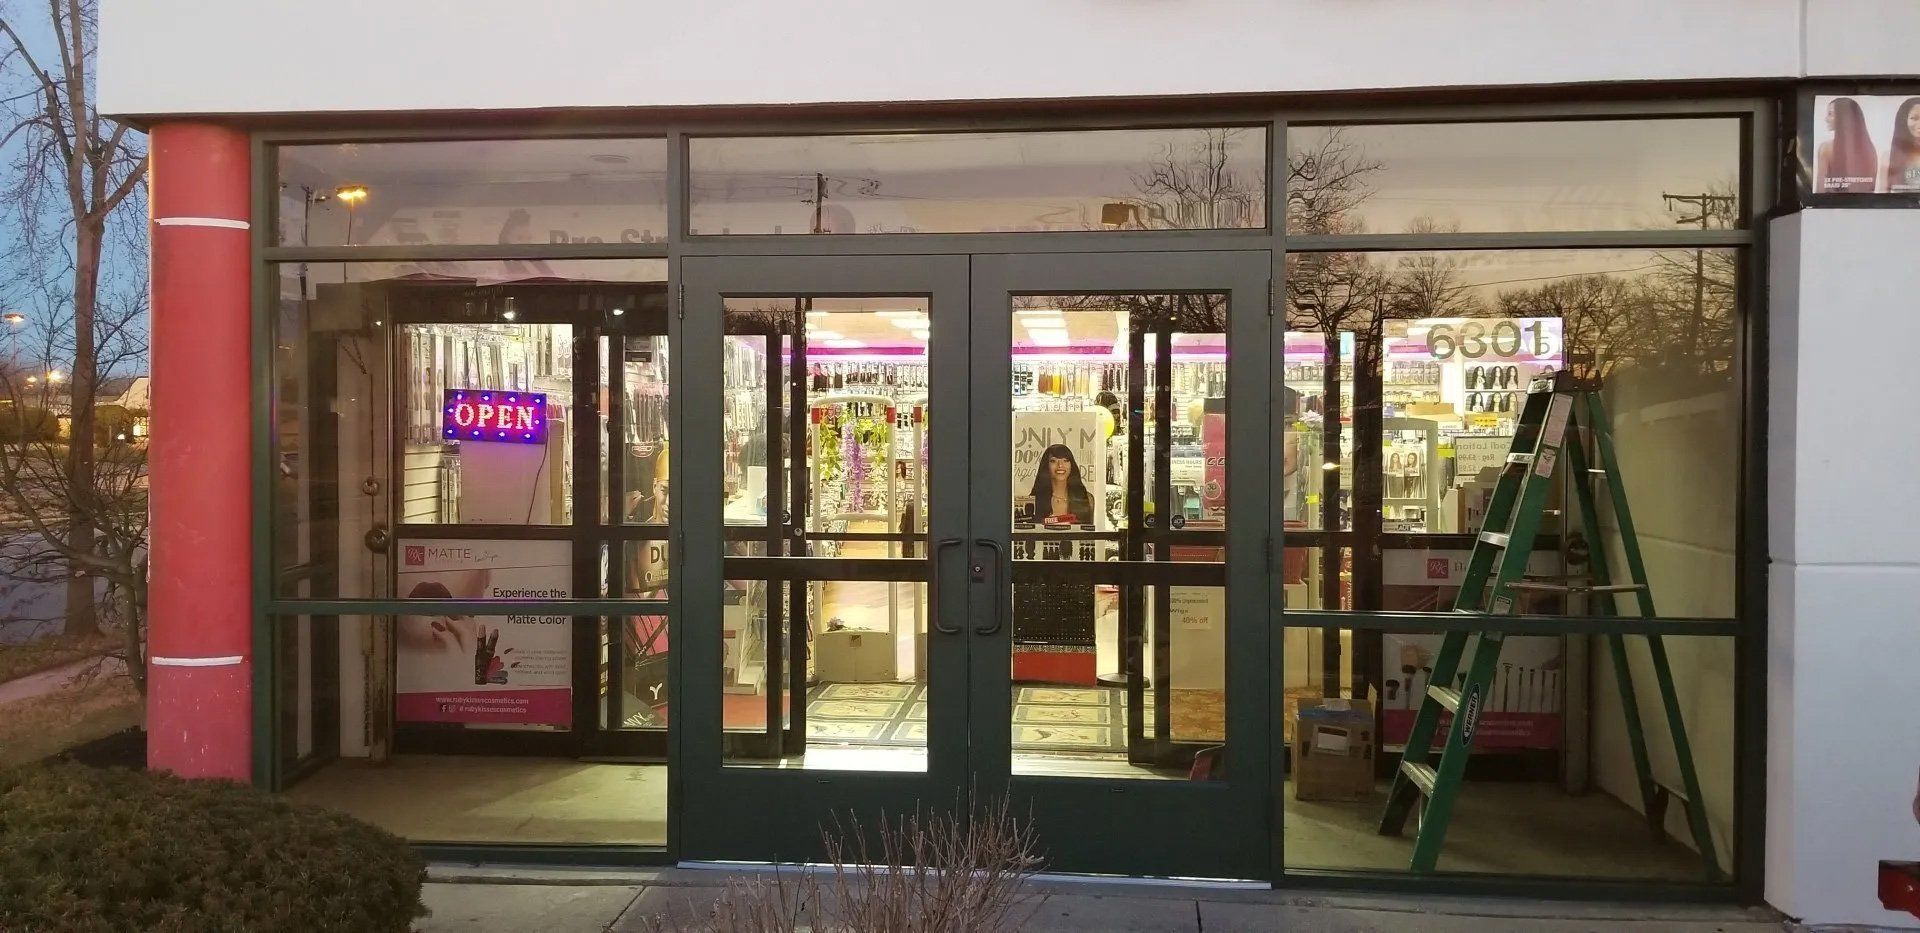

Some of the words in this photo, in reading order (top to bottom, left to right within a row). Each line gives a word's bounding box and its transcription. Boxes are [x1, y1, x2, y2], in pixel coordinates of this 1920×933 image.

[1426, 320, 1543, 359] 6301
[455, 403, 535, 430] OPEN
[428, 548, 472, 559] MATTE
[493, 587, 548, 598] Experience
[550, 588, 567, 598] the
[507, 615, 536, 624] Matte
[539, 615, 567, 624] Color
[1463, 695, 1478, 734] WERNER
